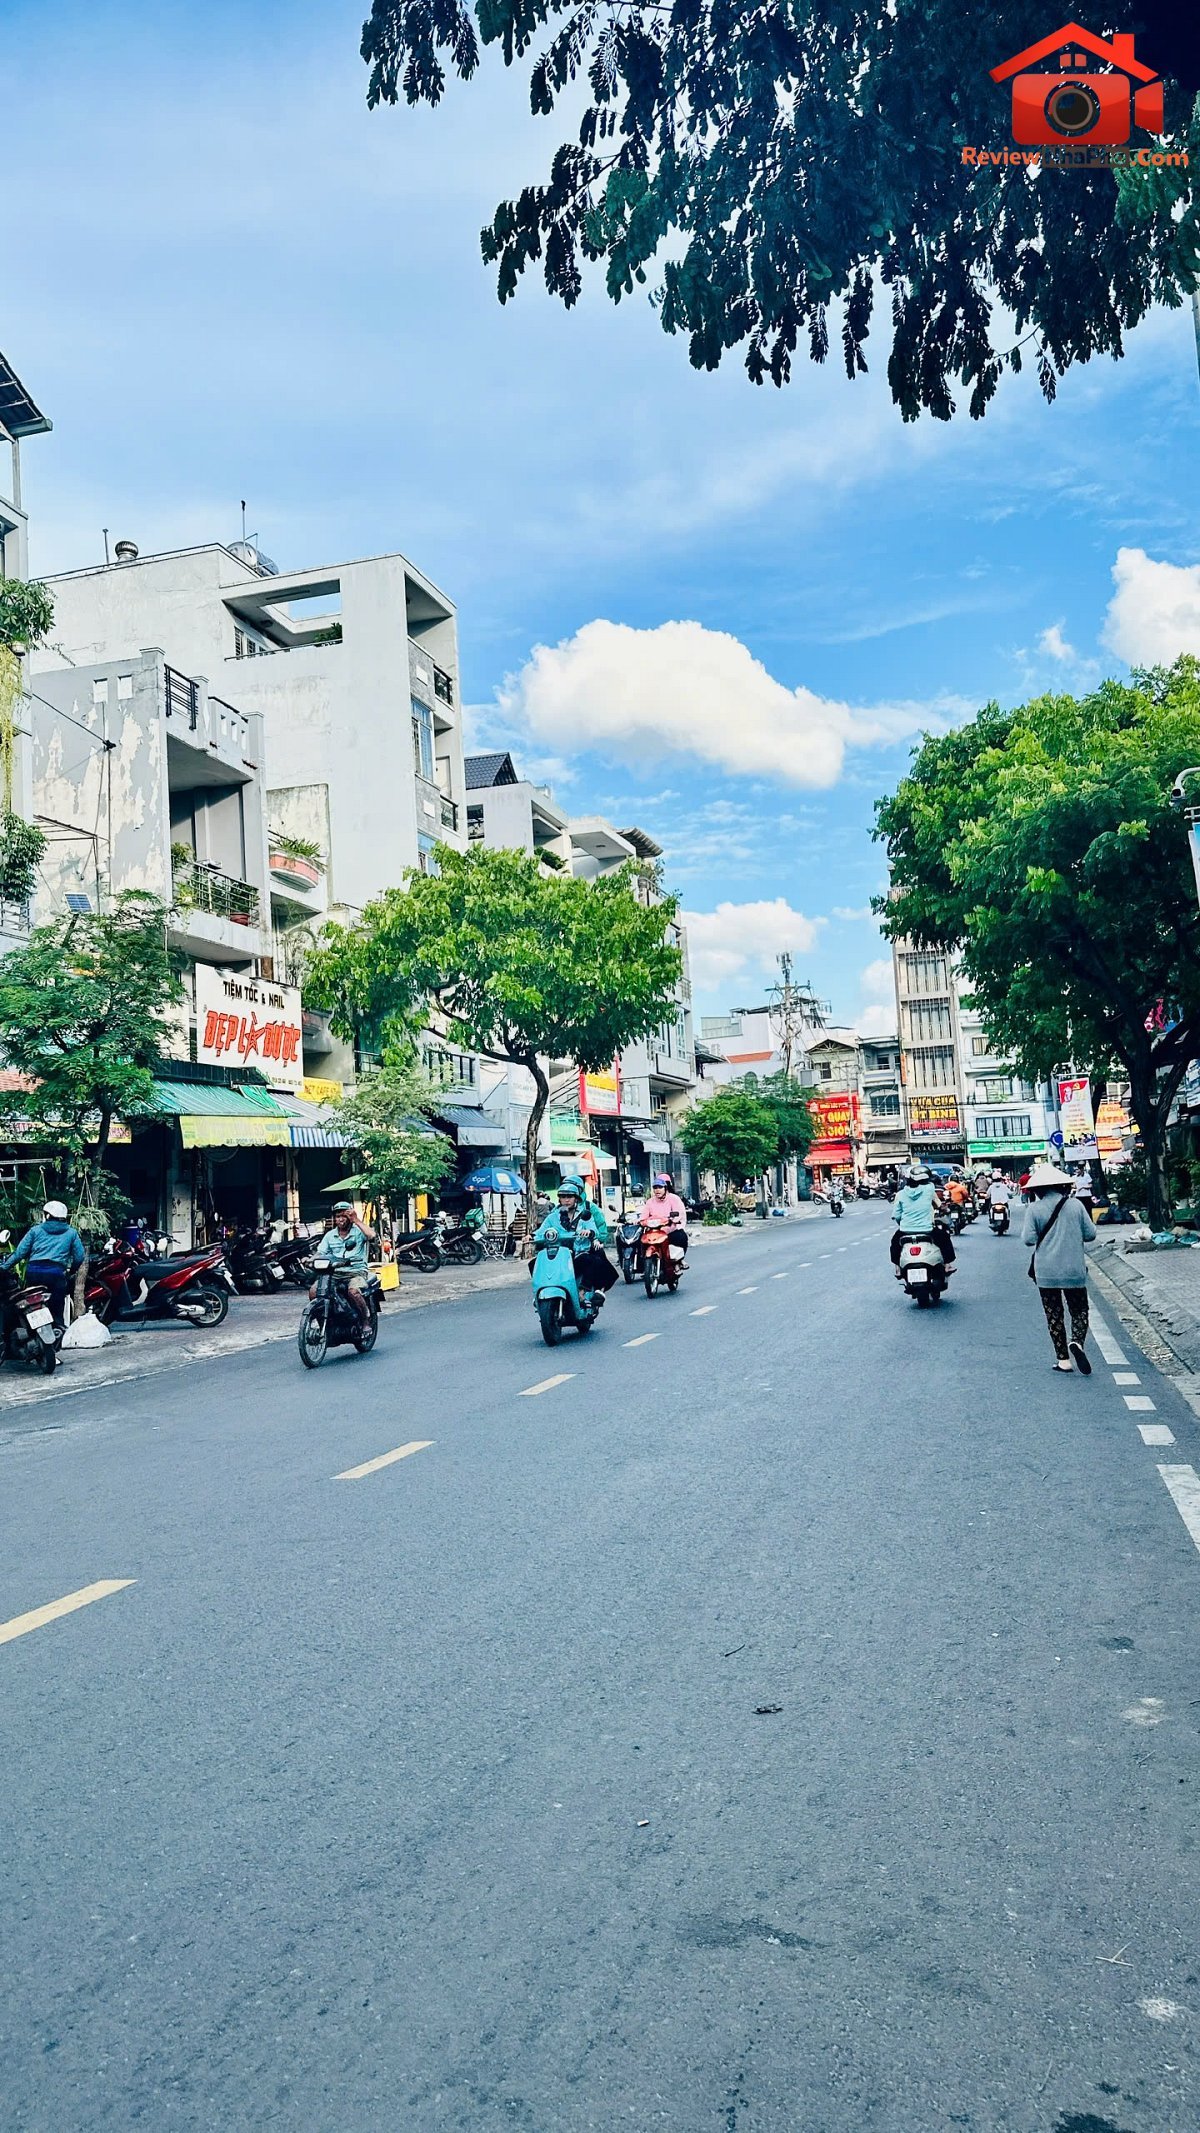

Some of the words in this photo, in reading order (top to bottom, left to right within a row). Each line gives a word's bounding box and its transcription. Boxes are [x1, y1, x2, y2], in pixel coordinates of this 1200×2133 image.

[223, 979, 242, 1000] TIỆM
[244, 984, 258, 1002] TÓC
[268, 992, 285, 1009] NAIL
[203, 1010, 239, 1057] ĐẸP
